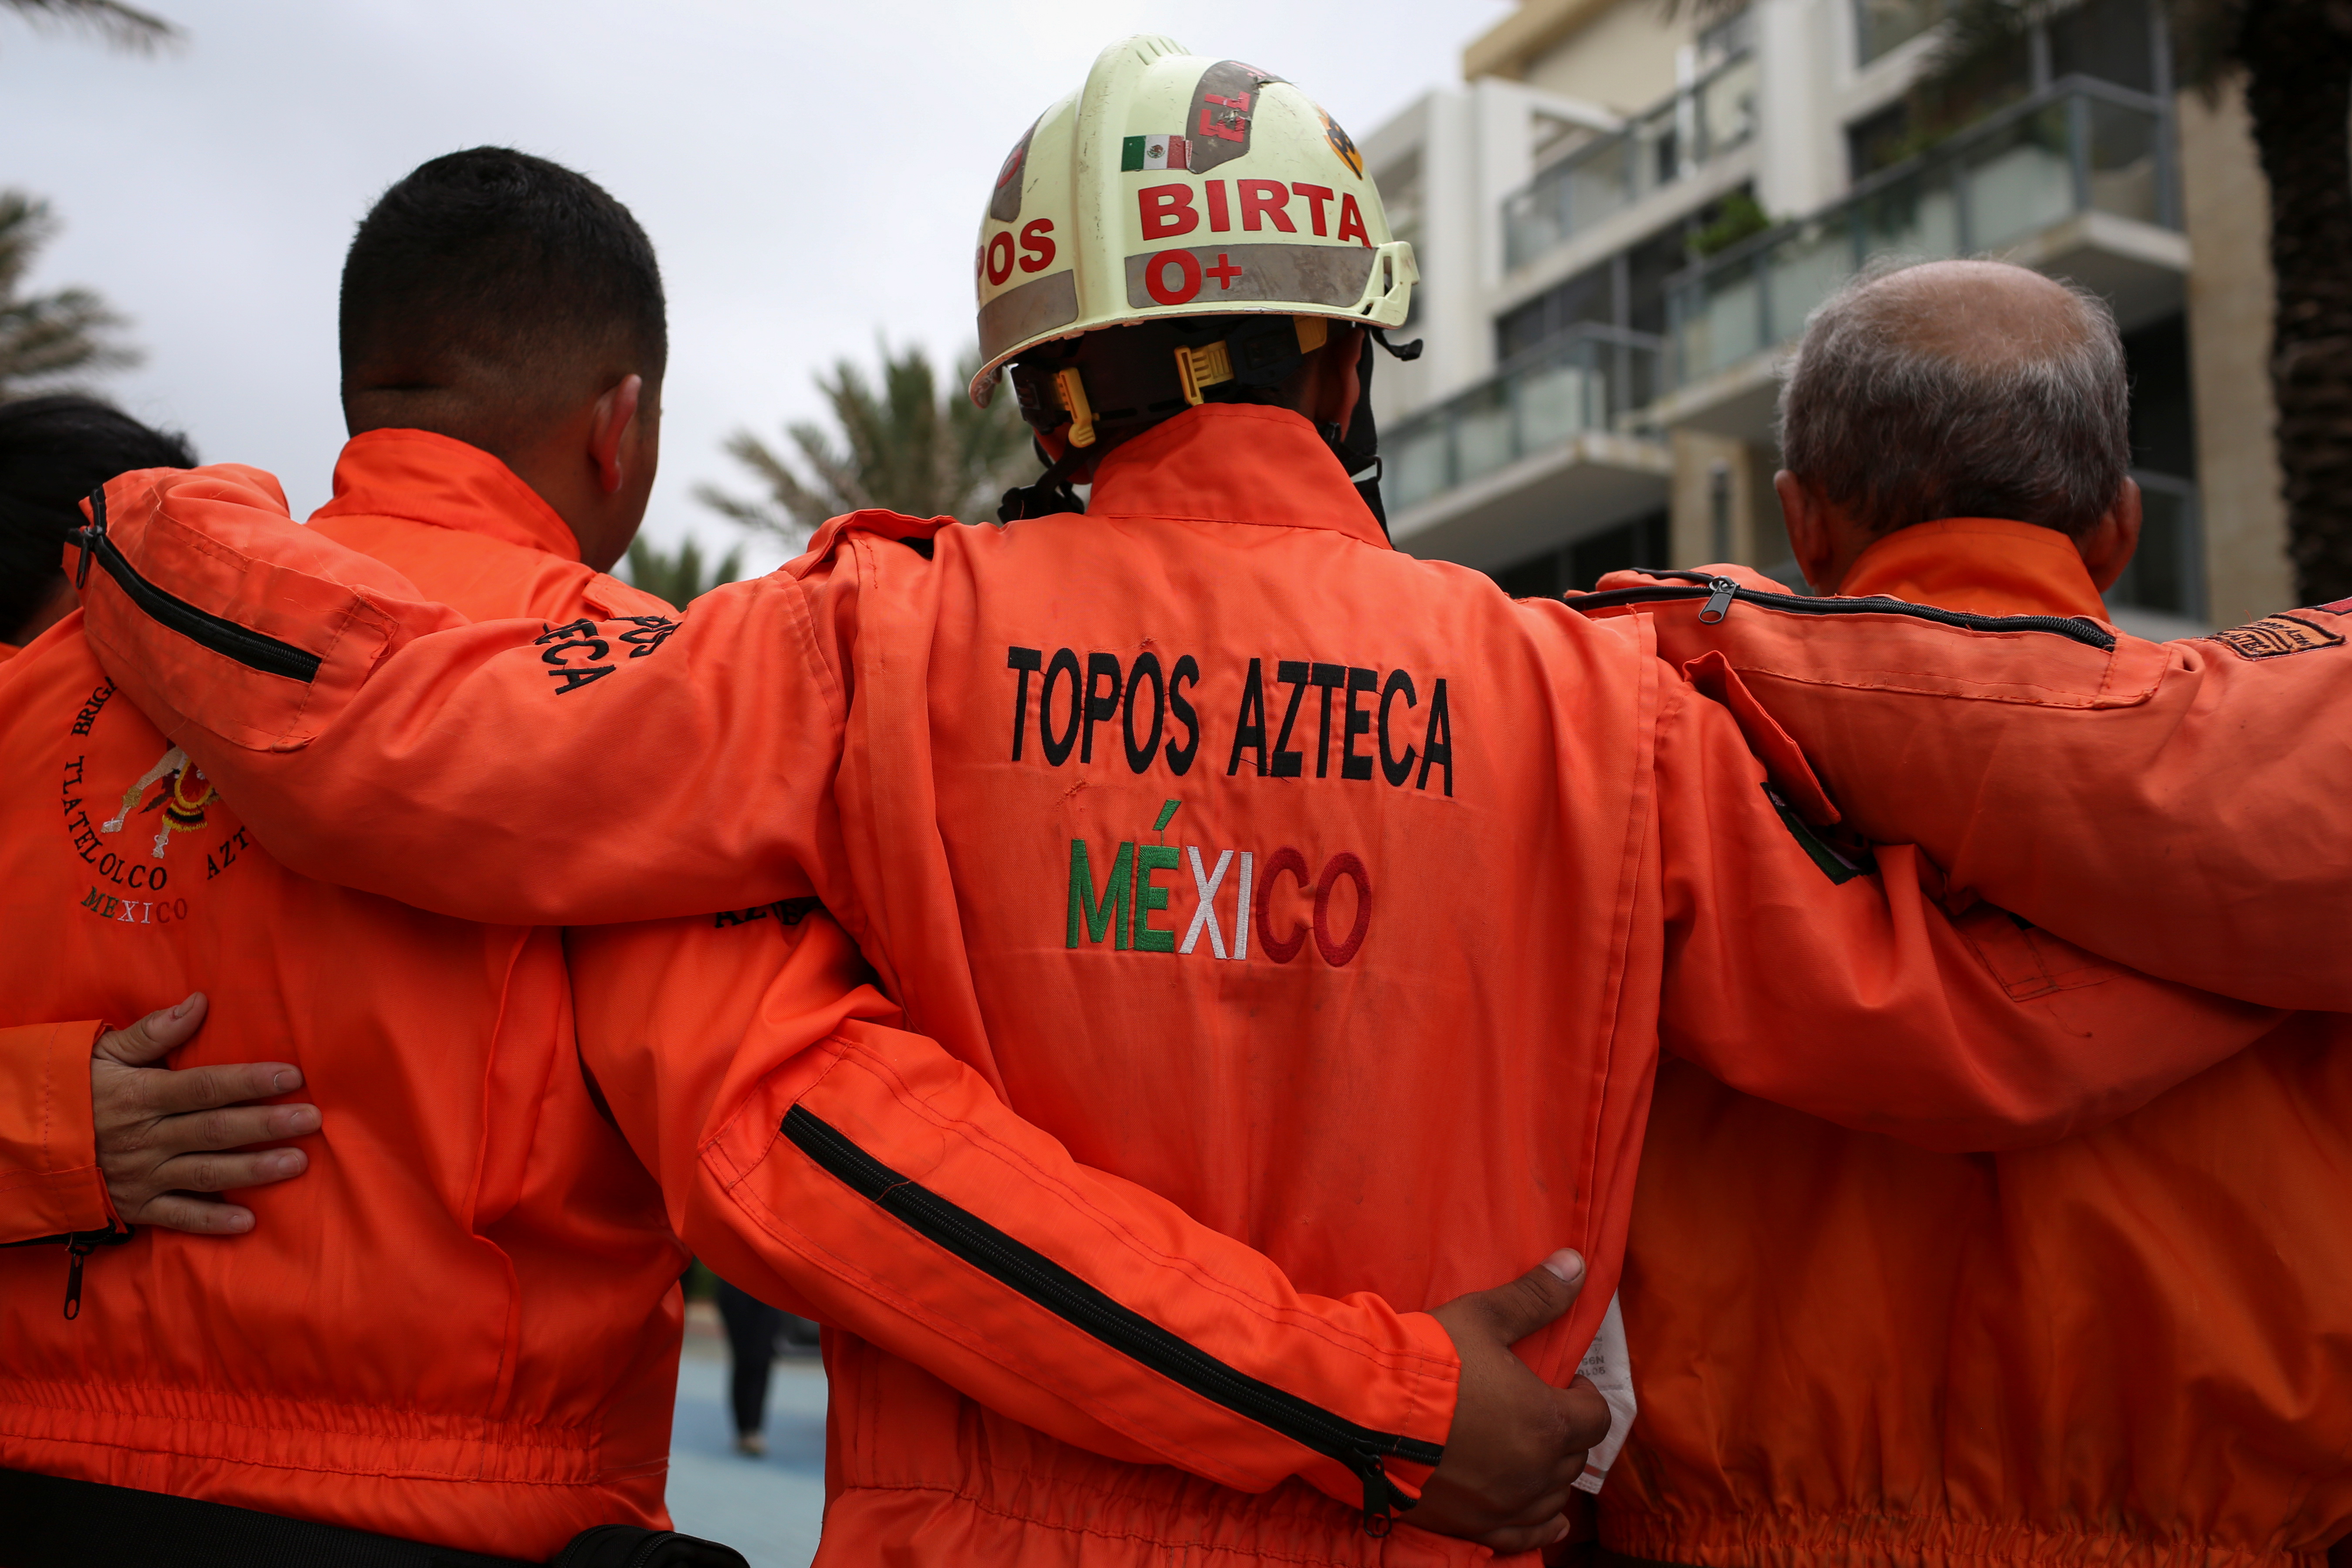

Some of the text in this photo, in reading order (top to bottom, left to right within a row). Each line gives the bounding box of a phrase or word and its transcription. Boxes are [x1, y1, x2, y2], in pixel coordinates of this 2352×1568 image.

[1139, 179, 1372, 248] BIRTA
[1145, 249, 1242, 305] O+
[1007, 646, 1453, 797] TOPOS AZTECA
[62, 755, 167, 891] TLATELOLCO
[81, 886, 188, 924] MEXICO
[1065, 800, 1372, 967] MÉXICO
